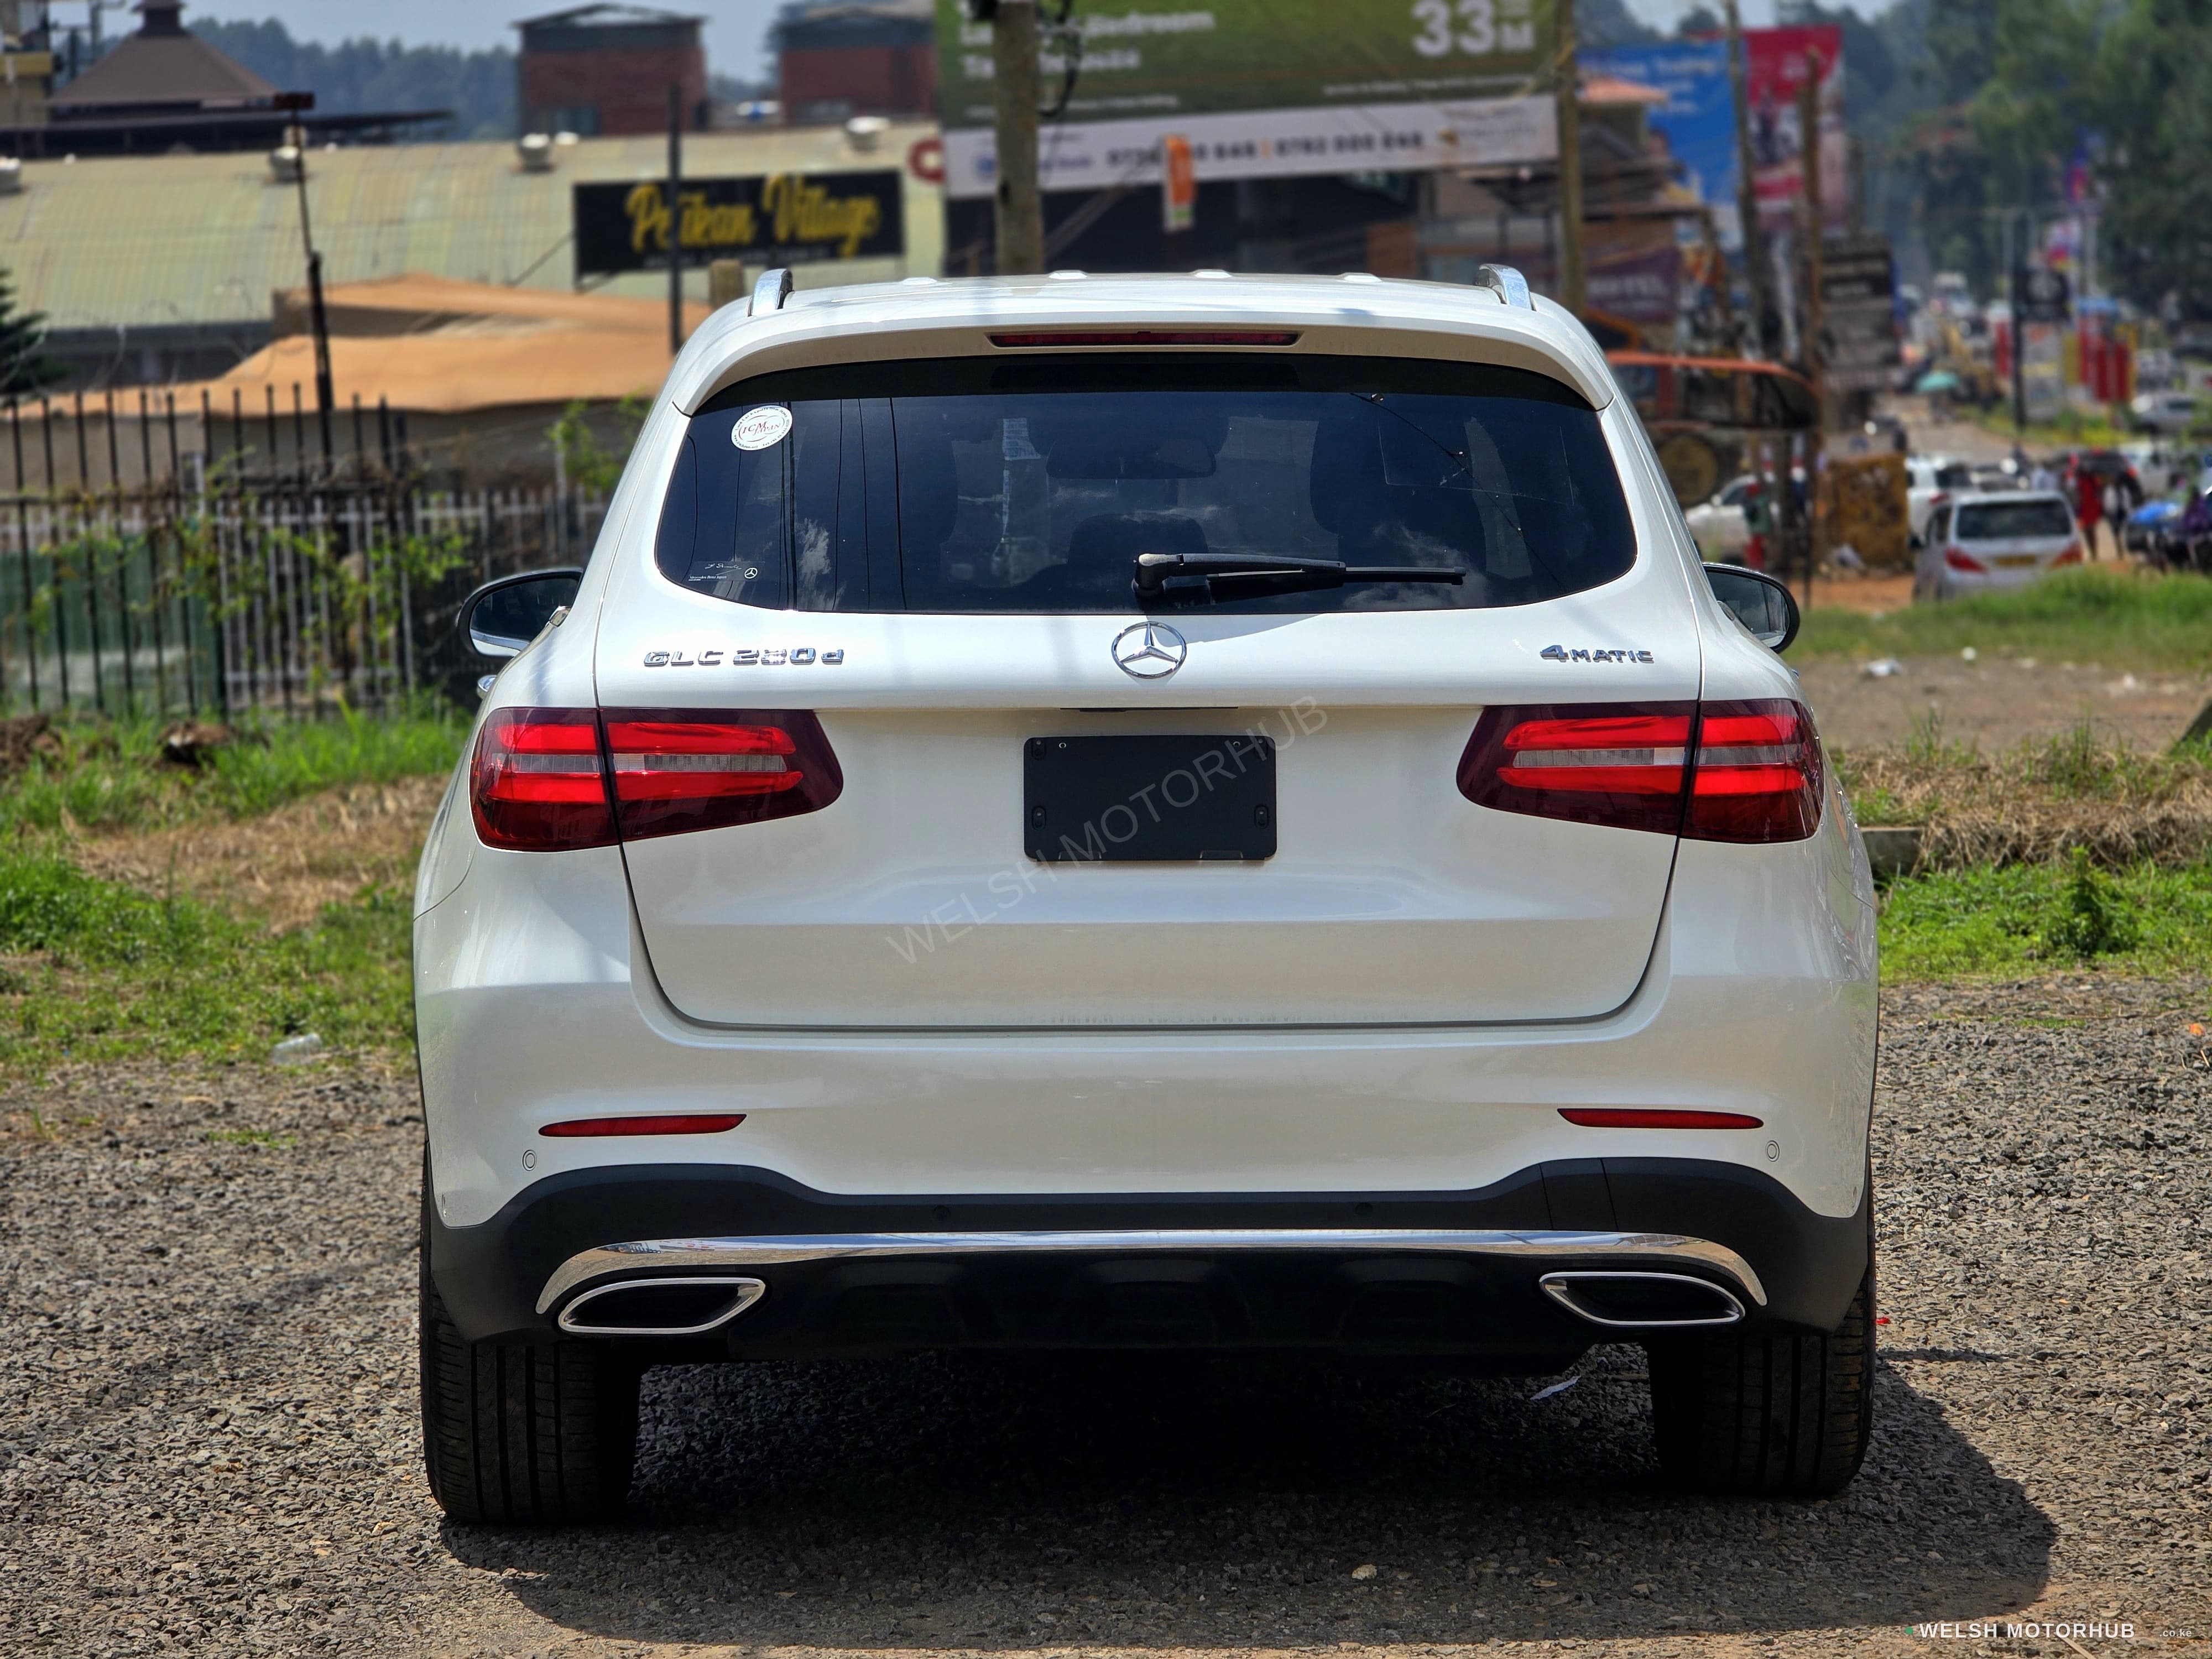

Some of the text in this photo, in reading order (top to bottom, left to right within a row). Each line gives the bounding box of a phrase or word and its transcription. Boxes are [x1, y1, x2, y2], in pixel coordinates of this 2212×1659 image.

[761, 171, 879, 262] Village
[742, 421, 767, 434] ICM
[752, 422, 781, 436] JAPAN
[644, 650, 723, 667] GLC
[1540, 644, 1655, 664] 4MATIC
